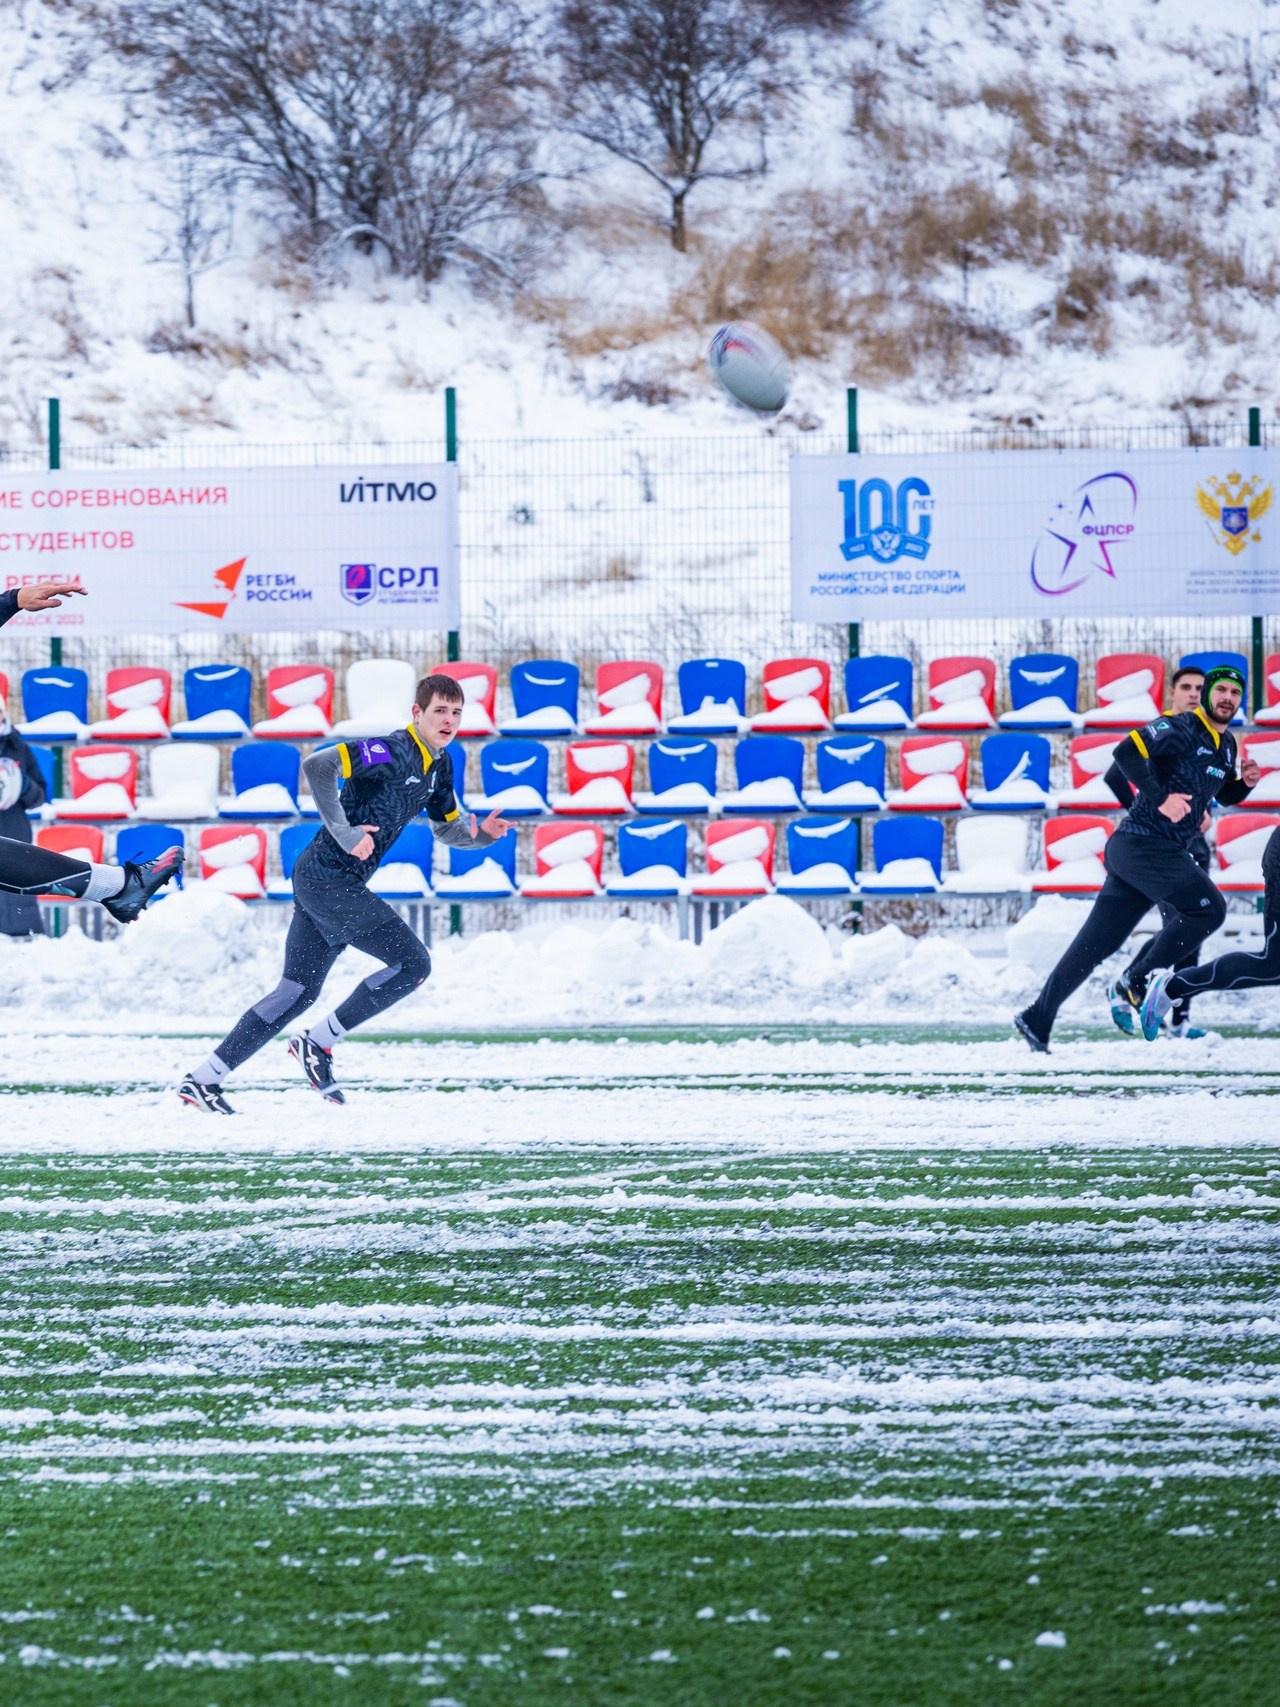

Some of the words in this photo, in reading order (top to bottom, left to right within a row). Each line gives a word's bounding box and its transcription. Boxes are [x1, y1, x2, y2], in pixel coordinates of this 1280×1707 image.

[32, 486, 228, 508] СОРЕВНОВАНИЯ
[912, 500, 936, 510] ЛЕТ
[1082, 524, 1135, 536] ФЦПСР
[246, 575, 296, 586] РЕГБИ
[378, 567, 439, 588] СРЛ
[818, 570, 912, 582] МИНИСТЕРСТВО
[915, 570, 961, 581] СПОРТА
[246, 589, 313, 601] РОССИИ
[810, 583, 889, 596] РОССИЙСКОЙ
[892, 584, 966, 595] ФЕДЕРАЦИИ
